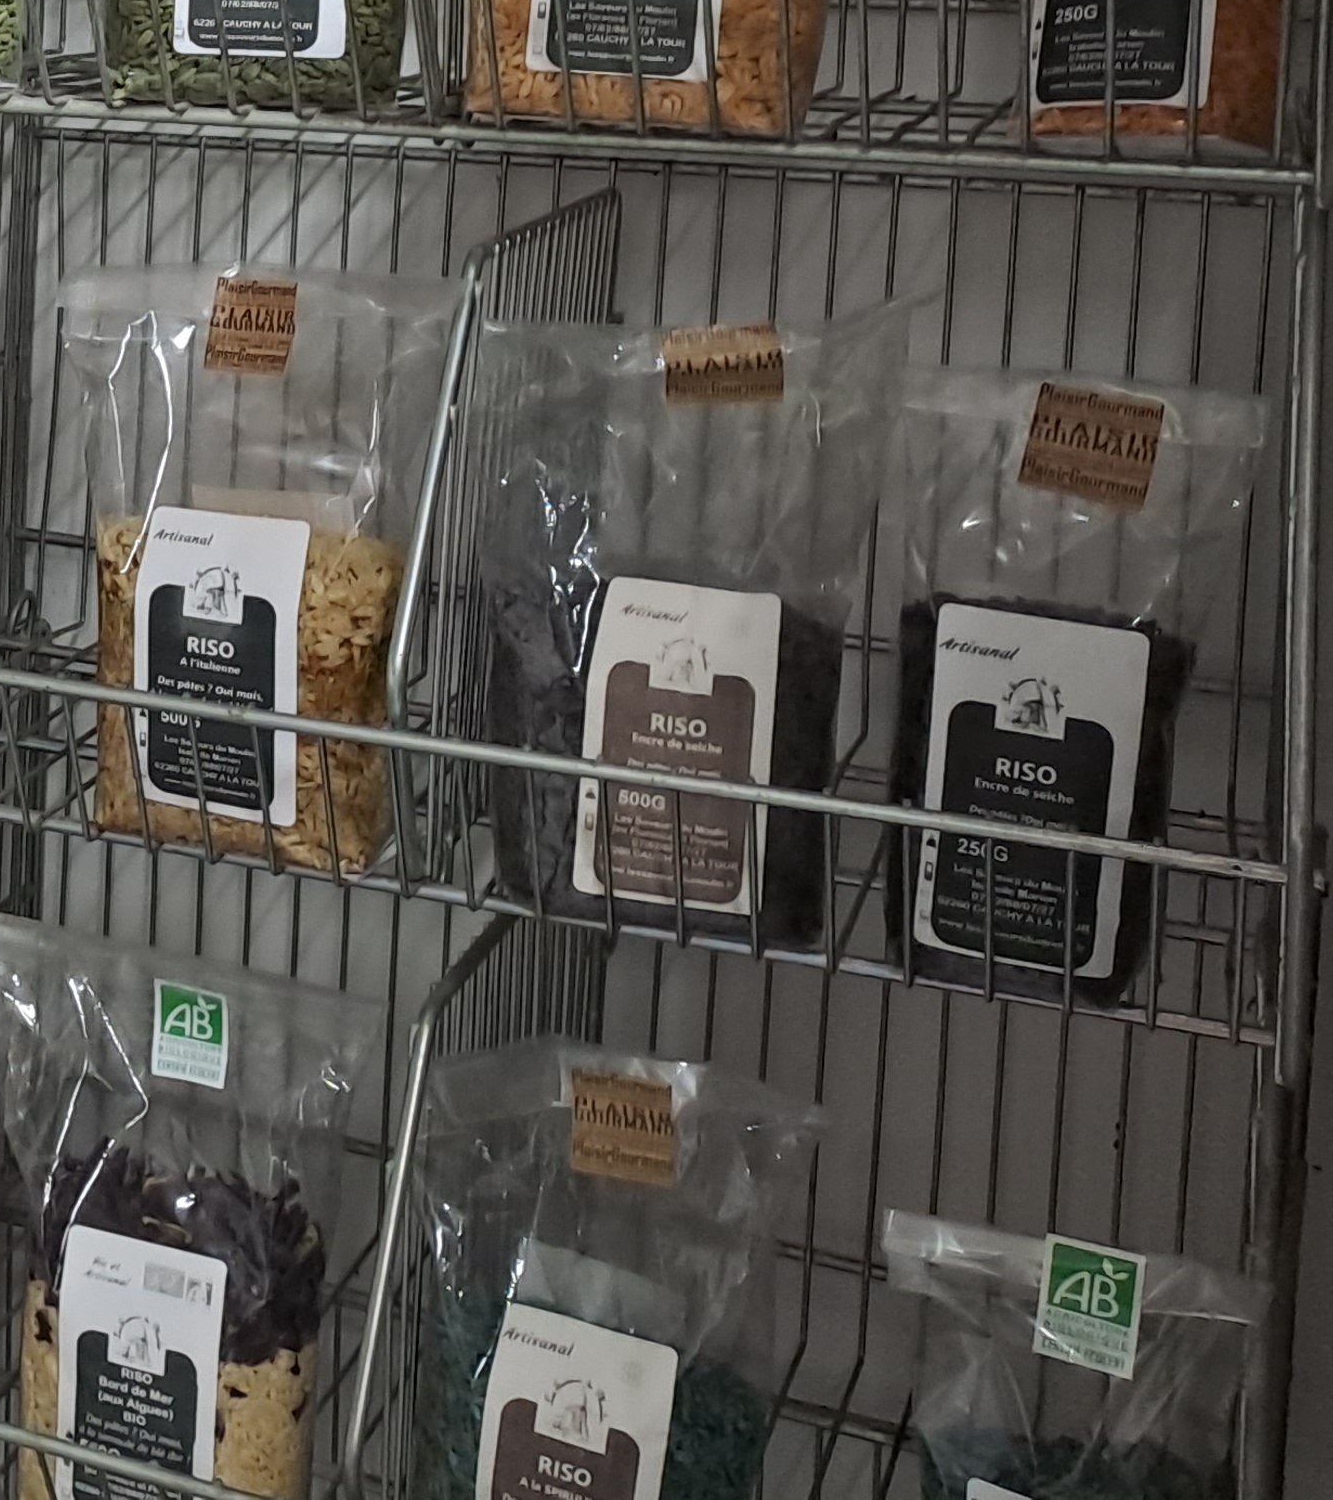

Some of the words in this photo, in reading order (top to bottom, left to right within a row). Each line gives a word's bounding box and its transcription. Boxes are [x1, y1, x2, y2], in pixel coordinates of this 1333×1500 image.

[153, 528, 214, 547] Artisanal
[187, 636, 235, 659] RISO
[939, 637, 1021, 661] Artisanal
[650, 713, 707, 738] RISO
[995, 757, 1058, 785] RISO
[974, 776, 1010, 795] Encre
[1013, 784, 1030, 797] de
[1033, 787, 1075, 806] seiche
[164, 1002, 214, 1040] AB
[1053, 1271, 1119, 1319] AB
[503, 1327, 576, 1357] Artisanal
[121, 1367, 153, 1385] RISO
[538, 1455, 592, 1487] RISO
